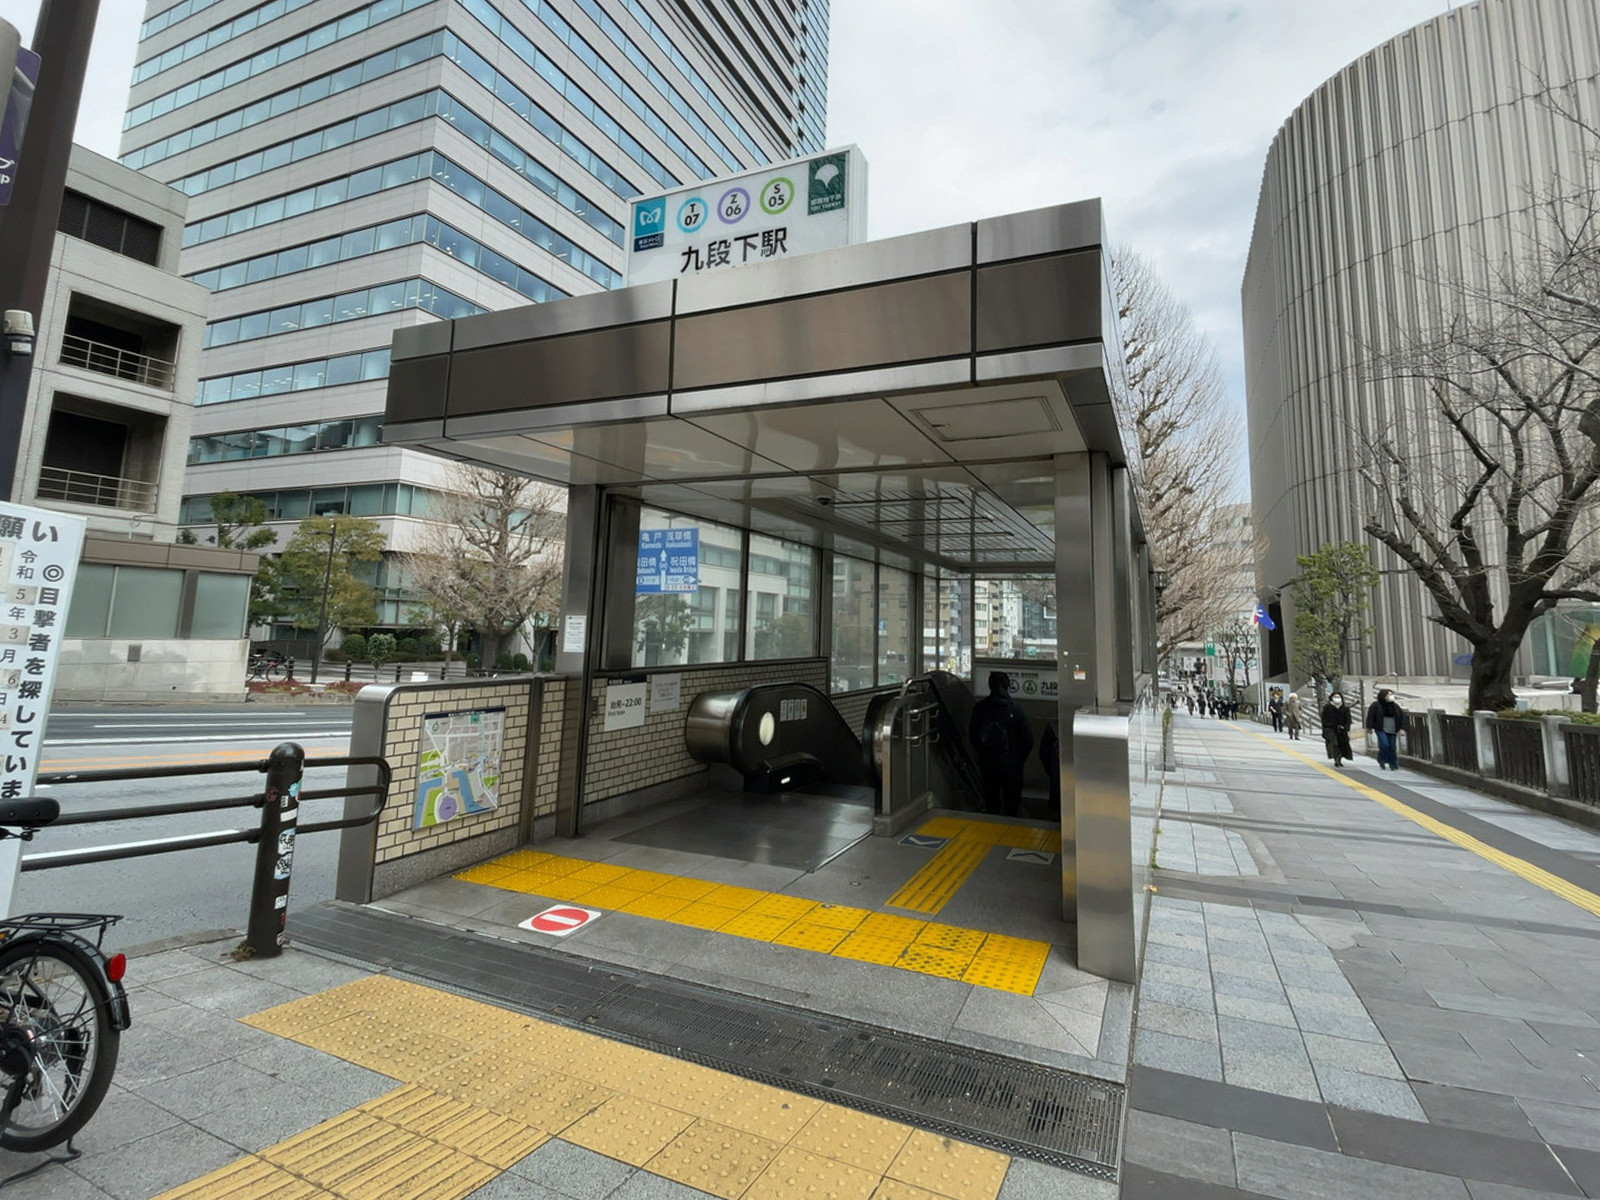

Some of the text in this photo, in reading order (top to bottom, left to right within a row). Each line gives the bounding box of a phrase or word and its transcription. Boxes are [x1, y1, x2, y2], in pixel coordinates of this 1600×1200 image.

[774, 184, 781, 194] S
[730, 193, 738, 203] Z
[768, 195, 785, 208] 05
[689, 203, 696, 213] T
[725, 205, 742, 217] 06
[684, 213, 700, 226] 07
[680, 226, 788, 273] 九段下駅
